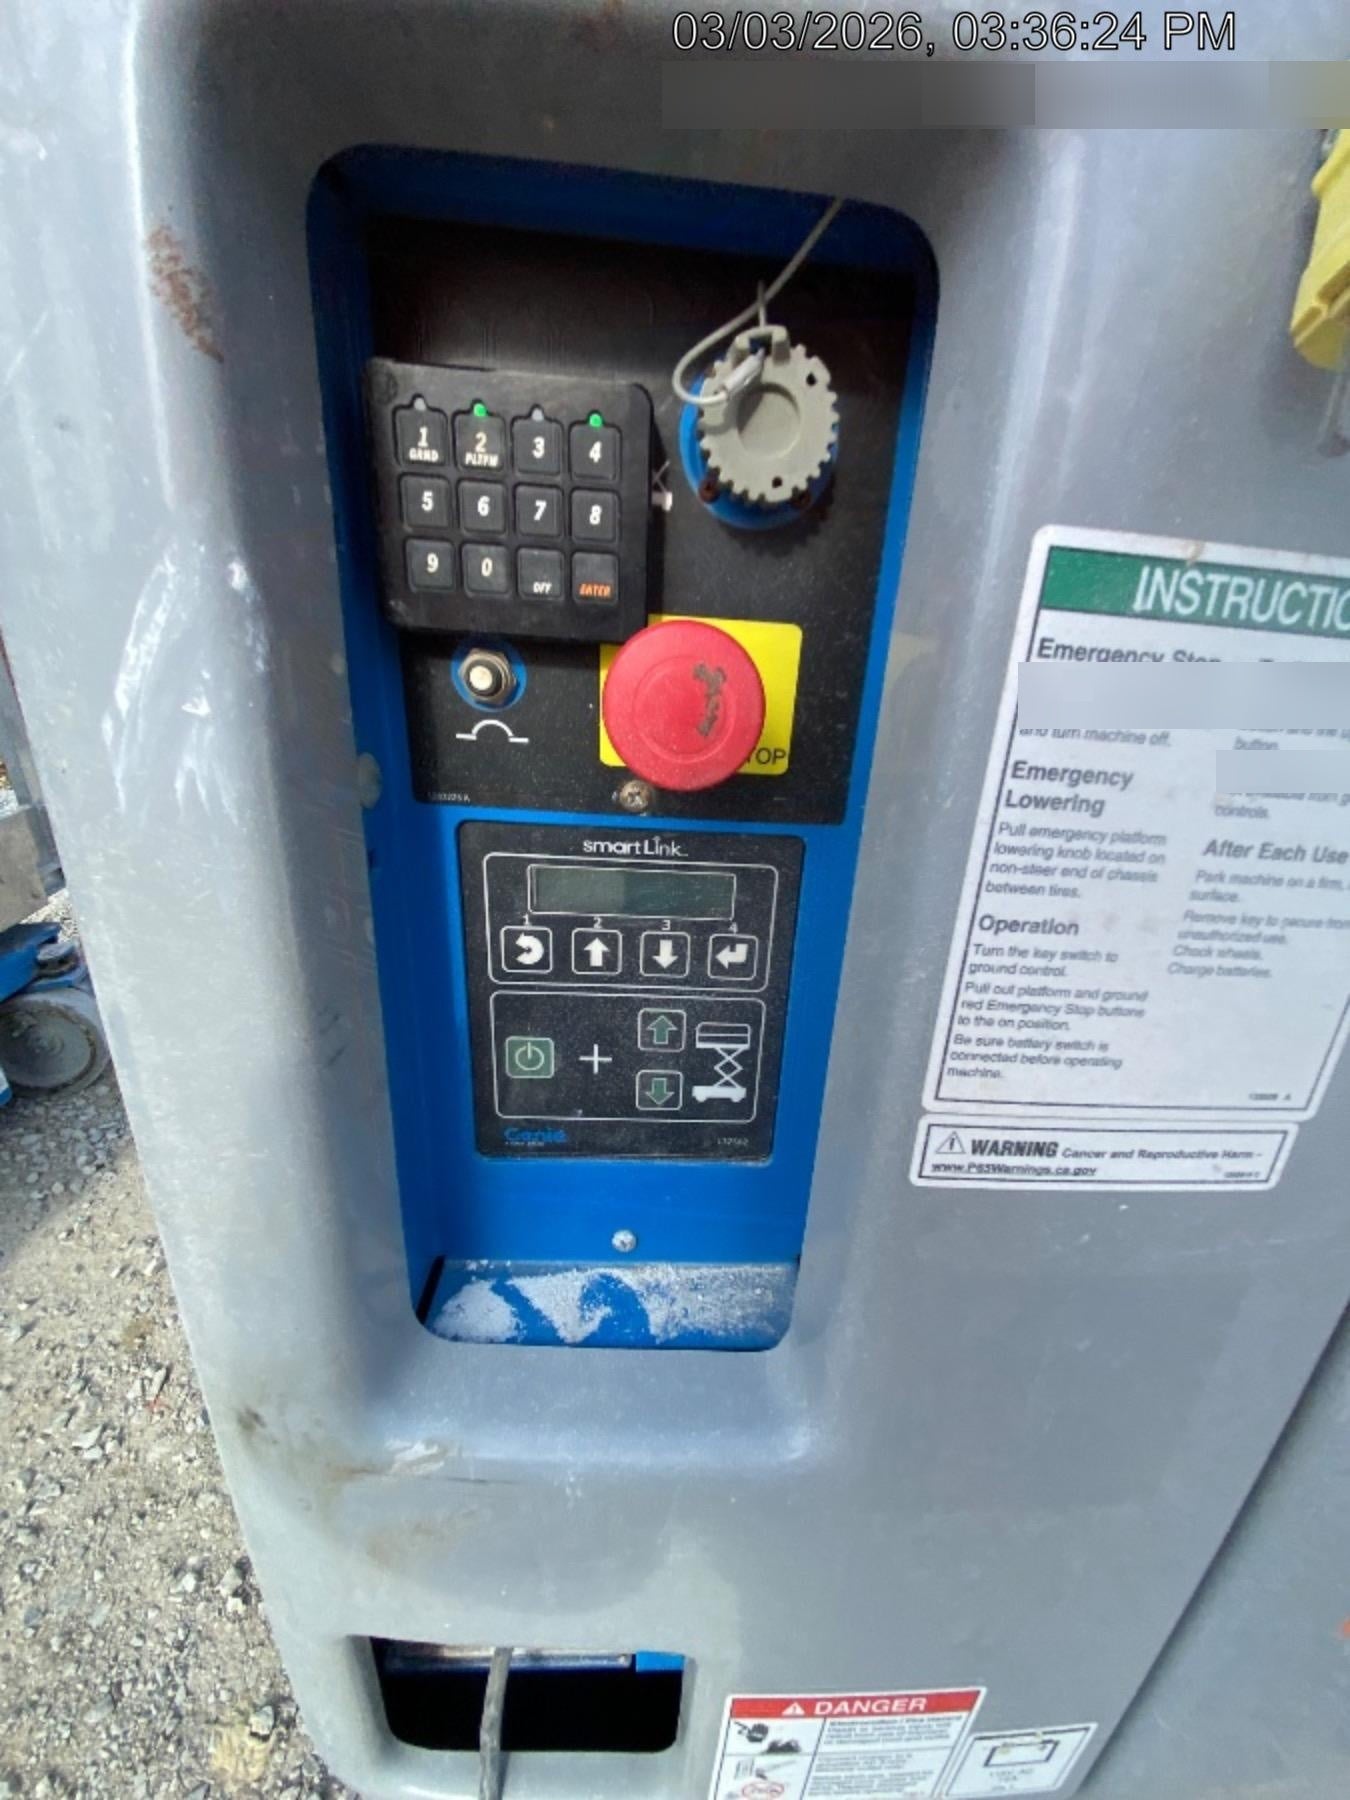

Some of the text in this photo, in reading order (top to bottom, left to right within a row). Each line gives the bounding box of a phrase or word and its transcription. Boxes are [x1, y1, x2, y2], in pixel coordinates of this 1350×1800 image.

[418, 427, 429, 448] 1
[475, 432, 488, 452] 2
[532, 437, 546, 458] 3
[589, 441, 603, 463] 4
[421, 491, 434, 511] 5
[477, 496, 490, 516] 6
[533, 500, 547, 521] 7
[589, 505, 602, 525] 8
[426, 552, 439, 573] 9
[481, 557, 493, 577] 0
[1010, 760, 1134, 790] Emergency
[1005, 789, 1105, 818] Lowering
[999, 822, 1167, 847] Pull emergency platform
[994, 841, 1054, 860] lowering
[1057, 845, 1092, 859] knob
[1095, 848, 1145, 864] located
[1202, 838, 1350, 865] After Each Use
[1061, 865, 1087, 879] end
[985, 881, 1046, 895] between
[522, 914, 530, 926] 1
[593, 917, 602, 928] 2
[662, 919, 672, 930] 3
[728, 922, 739, 934] 4
[978, 914, 1080, 936] Operation
[973, 943, 1005, 957] Turn
[1006, 945, 1029, 958] the
[968, 961, 1017, 976] ground
[964, 981, 991, 995] Pull
[986, 1001, 1061, 1016] Emergency
[970, 1138, 1059, 1158] WARNING
[814, 1697, 928, 1716] DANGER
